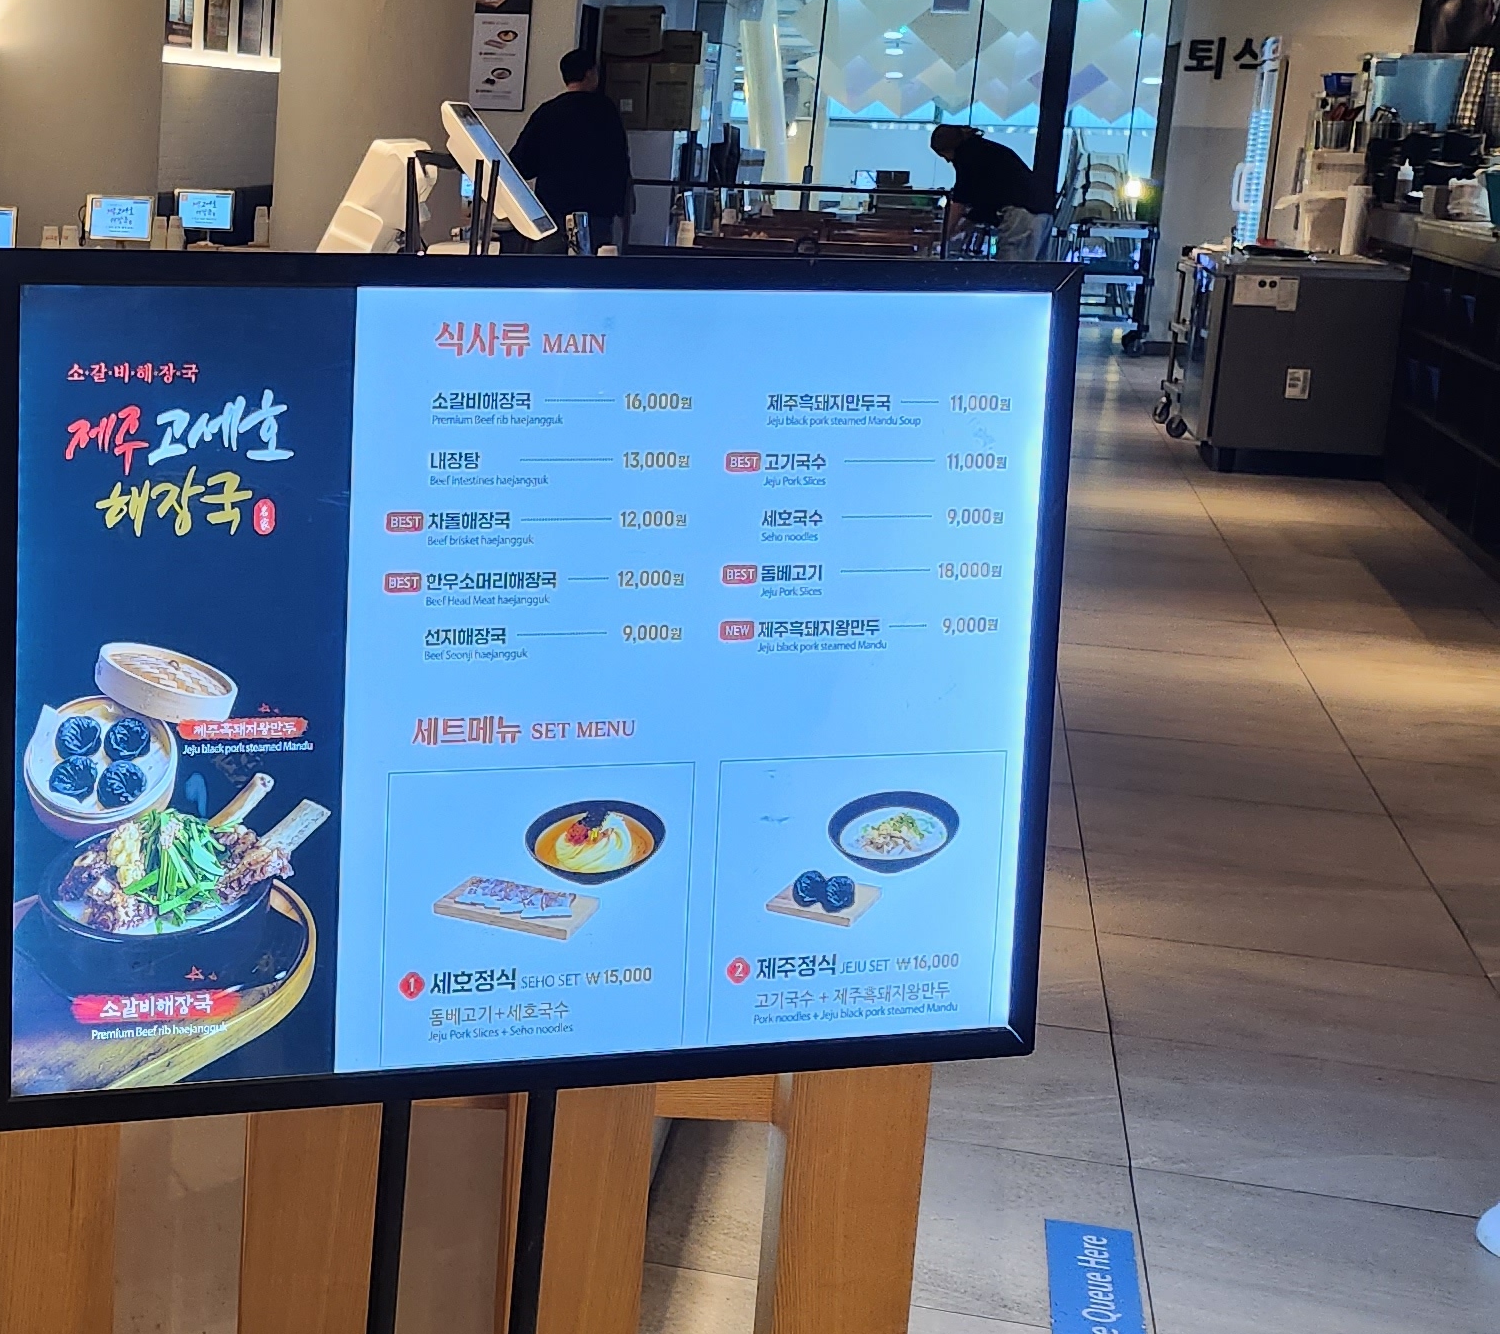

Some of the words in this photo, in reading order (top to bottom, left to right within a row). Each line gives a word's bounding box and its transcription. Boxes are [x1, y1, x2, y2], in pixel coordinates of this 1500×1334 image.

[435, 322, 530, 357] 식사류
[543, 334, 607, 354] MAIN
[432, 392, 531, 410] 소갈비해장국
[625, 393, 692, 411] 16,000원
[767, 394, 891, 412] 제주흑돼지만두국
[950, 395, 1011, 413] 11,000원
[432, 415, 472, 425] Premium
[474, 415, 495, 425] Beef
[497, 415, 508, 425] rib
[510, 415, 563, 427] haejangguk
[766, 416, 784, 427] Jeju
[786, 416, 808, 426] black
[809, 417, 829, 427] pork
[831, 416, 867, 426] steamed
[869, 416, 897, 426] Mandu
[899, 416, 921, 428] Soup
[65, 405, 149, 476] 제주
[148, 389, 294, 466] 고세호
[430, 452, 480, 470] 내장탕
[623, 452, 690, 470] 13,000원
[729, 456, 758, 469] BEST
[765, 454, 826, 471] 고기국수
[947, 453, 1007, 470] 11,000원
[430, 476, 450, 486] Beef
[452, 476, 494, 486] intestines
[496, 475, 548, 488] haejangguk
[764, 476, 780, 487] Jeju
[782, 476, 801, 486] Pork
[803, 476, 826, 486] Slices
[96, 466, 252, 537] 해장국
[390, 516, 421, 528] BEST
[428, 512, 510, 529] 차돌해장국
[620, 511, 687, 528] 12,000원
[762, 510, 823, 527] 세호국수
[948, 509, 1003, 526] 9,000원
[427, 536, 447, 546] Beef
[449, 536, 479, 546] brisket
[481, 535, 534, 547] haejangguk
[761, 532, 783, 542] Seho
[785, 532, 818, 542] noodles
[389, 577, 420, 589] BEST
[426, 572, 556, 590] 한우소머리해장국
[618, 570, 685, 588] 12,000원
[727, 569, 755, 580] BEST
[761, 565, 822, 582] 돔베고기
[938, 563, 1002, 580] 18,000원
[426, 596, 446, 606] Beef
[448, 596, 471, 605] Head
[473, 596, 495, 605] Meat
[497, 595, 550, 608] haejangguk
[761, 587, 777, 599] Jeju
[779, 587, 798, 596] Pork
[800, 586, 822, 596] Slices
[425, 628, 506, 646] 선지해장국
[623, 625, 682, 642] 9,000원
[725, 625, 750, 636] NEW
[758, 620, 880, 637] 제주흑돼지왕만두
[943, 618, 998, 636] 9,000원
[425, 651, 444, 660] Beef
[445, 650, 473, 662] Seonji
[475, 649, 528, 662] haejangguk
[758, 642, 775, 653] Jeju
[776, 642, 799, 652] black
[800, 642, 819, 653] pork
[821, 641, 856, 651] steamed
[858, 639, 887, 650] Mandu
[412, 716, 521, 745] 세트메뉴
[531, 722, 570, 740] SET
[577, 720, 636, 739] MENU
[183, 745, 200, 756] Jeju
[202, 744, 224, 754] black
[225, 744, 245, 755] pork
[246, 742, 282, 753] steamed
[283, 741, 313, 751] Mandu
[756, 954, 837, 980] 제주정식
[840, 961, 865, 974] JEJU
[869, 959, 890, 973] SET
[430, 968, 516, 995] 세호정식
[521, 975, 554, 989] SEHO
[558, 973, 581, 987] SET
[754, 991, 815, 1009] 고기국수
[834, 982, 950, 1005] 제주흑돼지왕만두
[100, 995, 213, 1018] 소갈비해장국
[754, 1013, 774, 1024] Pork
[775, 1012, 811, 1023] noodles
[820, 1010, 839, 1021] Jeju
[840, 1008, 863, 1019] black
[865, 1007, 886, 1019] pork
[887, 1004, 924, 1016] steamed
[926, 1002, 958, 1013] Mandu
[92, 1028, 134, 1040] Premium
[136, 1026, 155, 1037] Beef
[158, 1025, 171, 1036] rib
[428, 1031, 447, 1043] Jeju
[450, 1029, 471, 1039] Pork
[473, 1027, 499, 1039] Slices
[510, 1025, 534, 1037] Seho
[536, 1023, 574, 1035] noodles
[1077, 1234, 1110, 1272] Here
[1081, 1273, 1122, 1324] Queue
